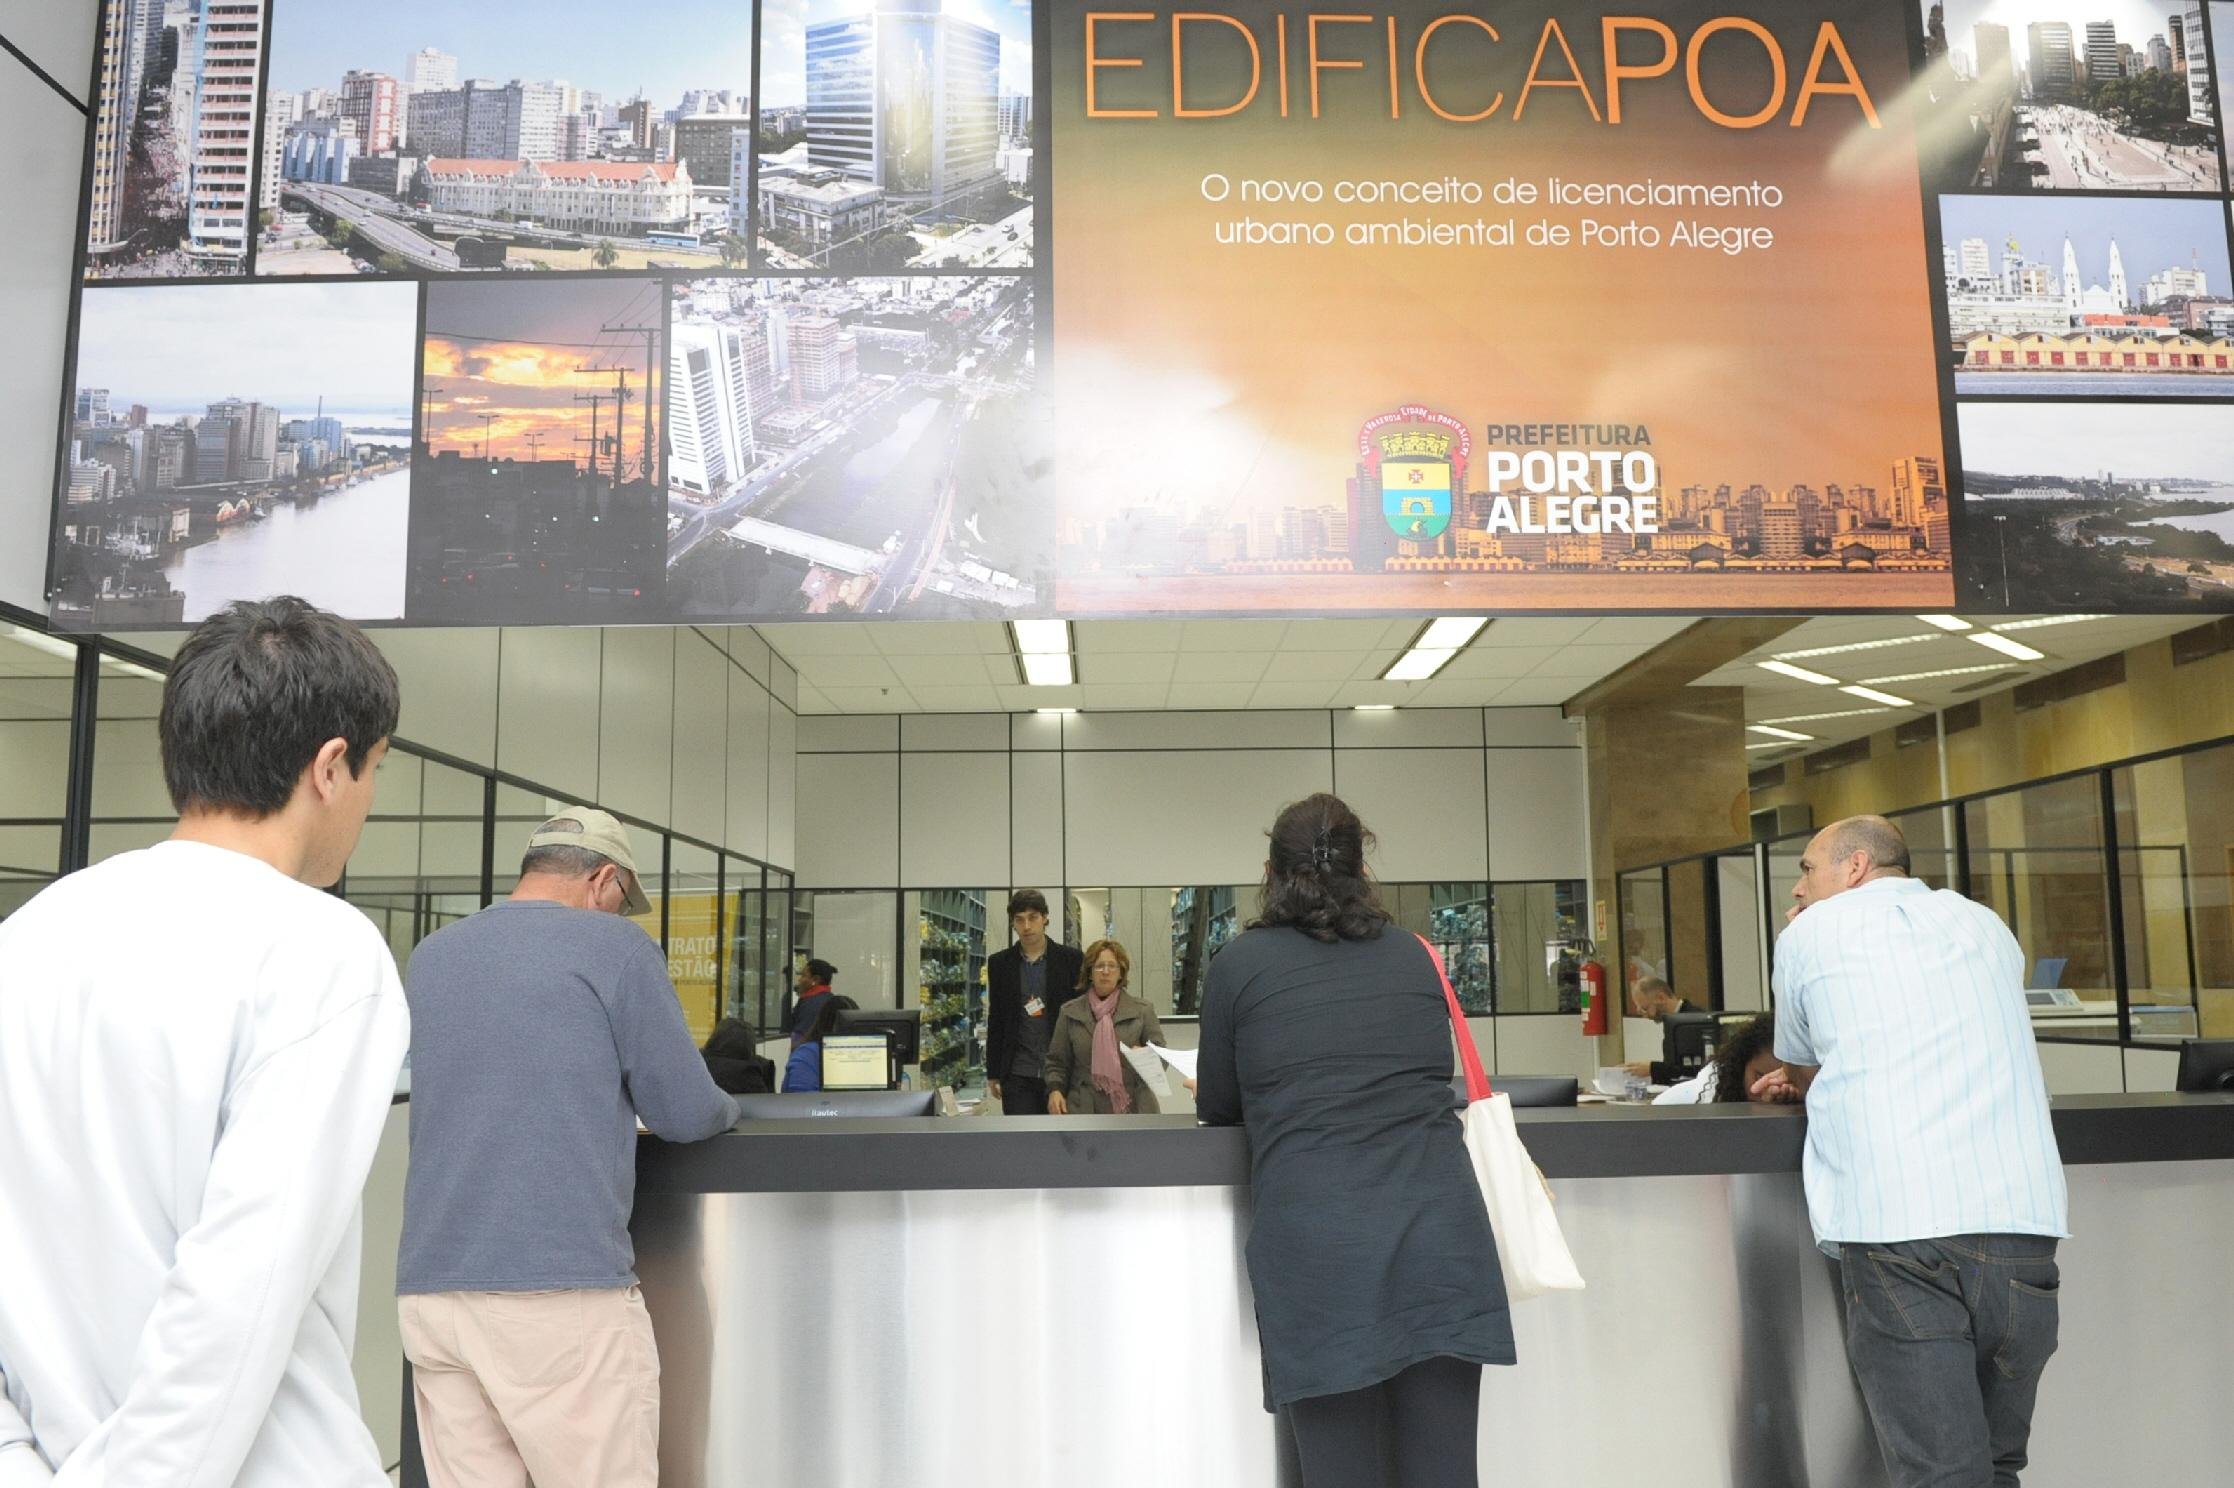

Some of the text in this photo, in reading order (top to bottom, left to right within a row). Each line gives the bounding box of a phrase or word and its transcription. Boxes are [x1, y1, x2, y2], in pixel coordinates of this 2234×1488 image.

[1085, 11, 1882, 129] EDIFICAPOA
[1201, 173, 1783, 207] O novo conceito de licenciamento
[1215, 216, 1774, 255] urbano ambiental de Porto Alegre
[1487, 424, 1651, 445] PREFEITURA
[1487, 450, 1656, 493] PORTO
[1486, 496, 1659, 534] ALEGRE
[667, 936, 717, 955] TRATO
